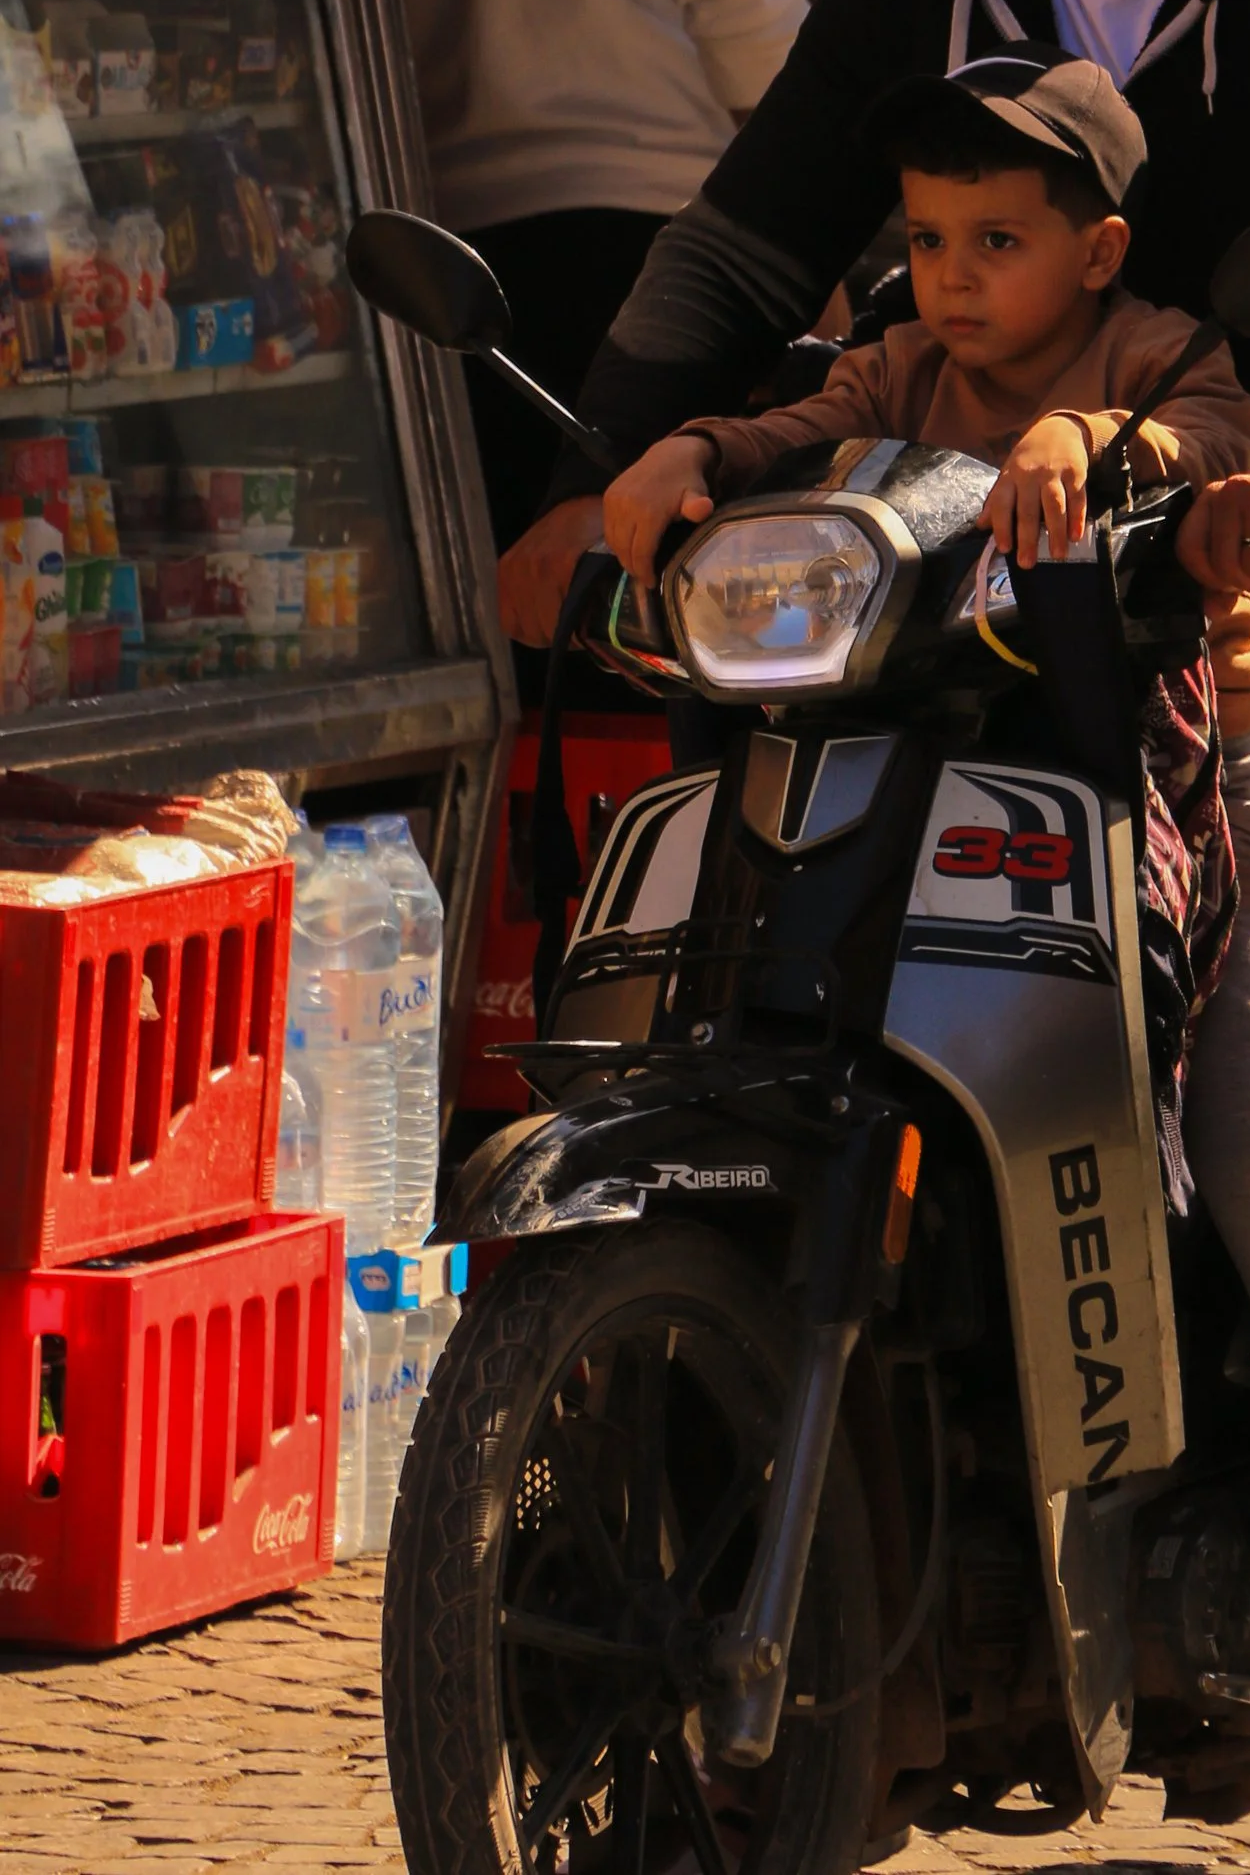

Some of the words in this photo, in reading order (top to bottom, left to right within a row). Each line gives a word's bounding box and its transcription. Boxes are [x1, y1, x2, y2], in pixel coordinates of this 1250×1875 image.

[932, 826, 1074, 886] 33
[634, 1163, 768, 1190] RIBEIRO
[253, 1491, 313, 1555] Coca-Cola
